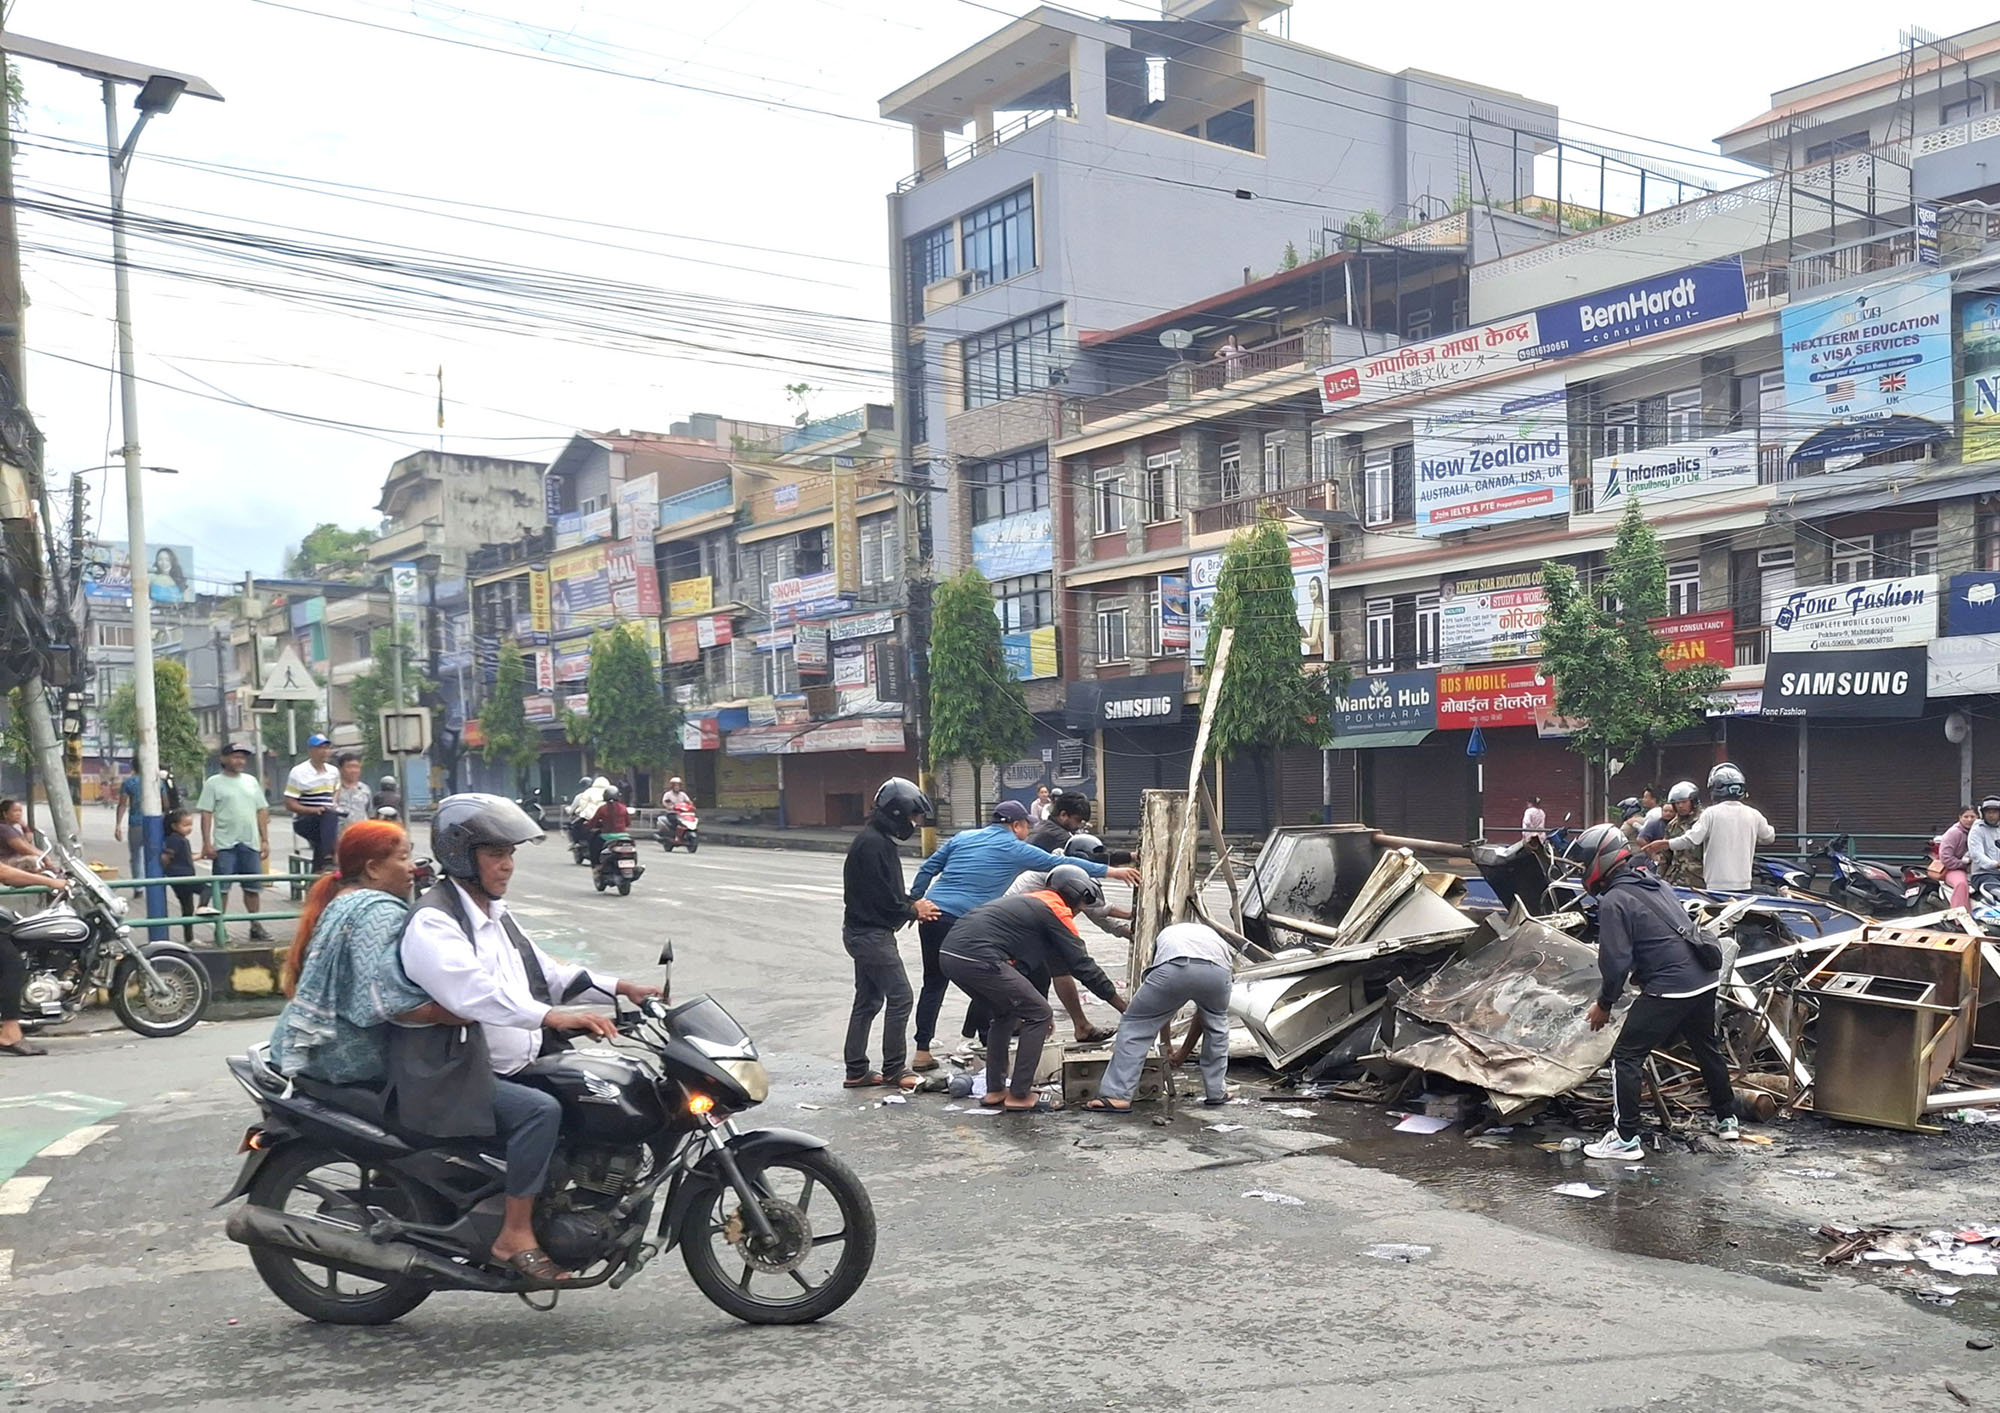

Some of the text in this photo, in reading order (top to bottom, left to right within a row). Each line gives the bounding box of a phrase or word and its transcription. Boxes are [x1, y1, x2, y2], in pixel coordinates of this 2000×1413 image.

[1579, 278, 1696, 332] BernHardt
[1593, 310, 1691, 341] consultant
[1863, 314, 1940, 339] EDUCATION
[1363, 321, 1529, 379] जापानिज भाषा केन्द्र
[1811, 334, 1920, 364] & VISA SERVICES
[1328, 376, 1356, 394] JLCC
[1832, 405, 1850, 415] USA
[1886, 396, 1900, 405] UK
[1421, 432, 1561, 483] New Zealand
[1626, 455, 1701, 483] Informatics
[1420, 483, 1473, 502] AUSTRALIA,
[1521, 469, 1546, 483] USA,
[1548, 464, 1563, 478] UK
[1450, 506, 1471, 518] IELTS
[1480, 501, 1495, 513] PTE
[1480, 577, 1495, 591] STAR
[1496, 572, 1530, 588] EDUCATION
[1493, 595, 1515, 606] STUDY
[1789, 583, 1924, 622] Fone Fashion
[1499, 609, 1542, 629] कोरियन
[1680, 621, 1724, 632] CONSULTANCY
[1843, 619, 1869, 628] MOBILE
[1870, 615, 1911, 625] SOLUTION)
[1465, 673, 1507, 691] MOBILE
[1781, 671, 1909, 696] SAMSUNG
[1105, 697, 1171, 720] SAMSUNG
[1335, 687, 1430, 713] Mantra Hub
[1441, 691, 1547, 714] मोबाईल होलसेल
[1762, 707, 1807, 716] Fone Fashion
[1345, 709, 1420, 723] POKHARA
